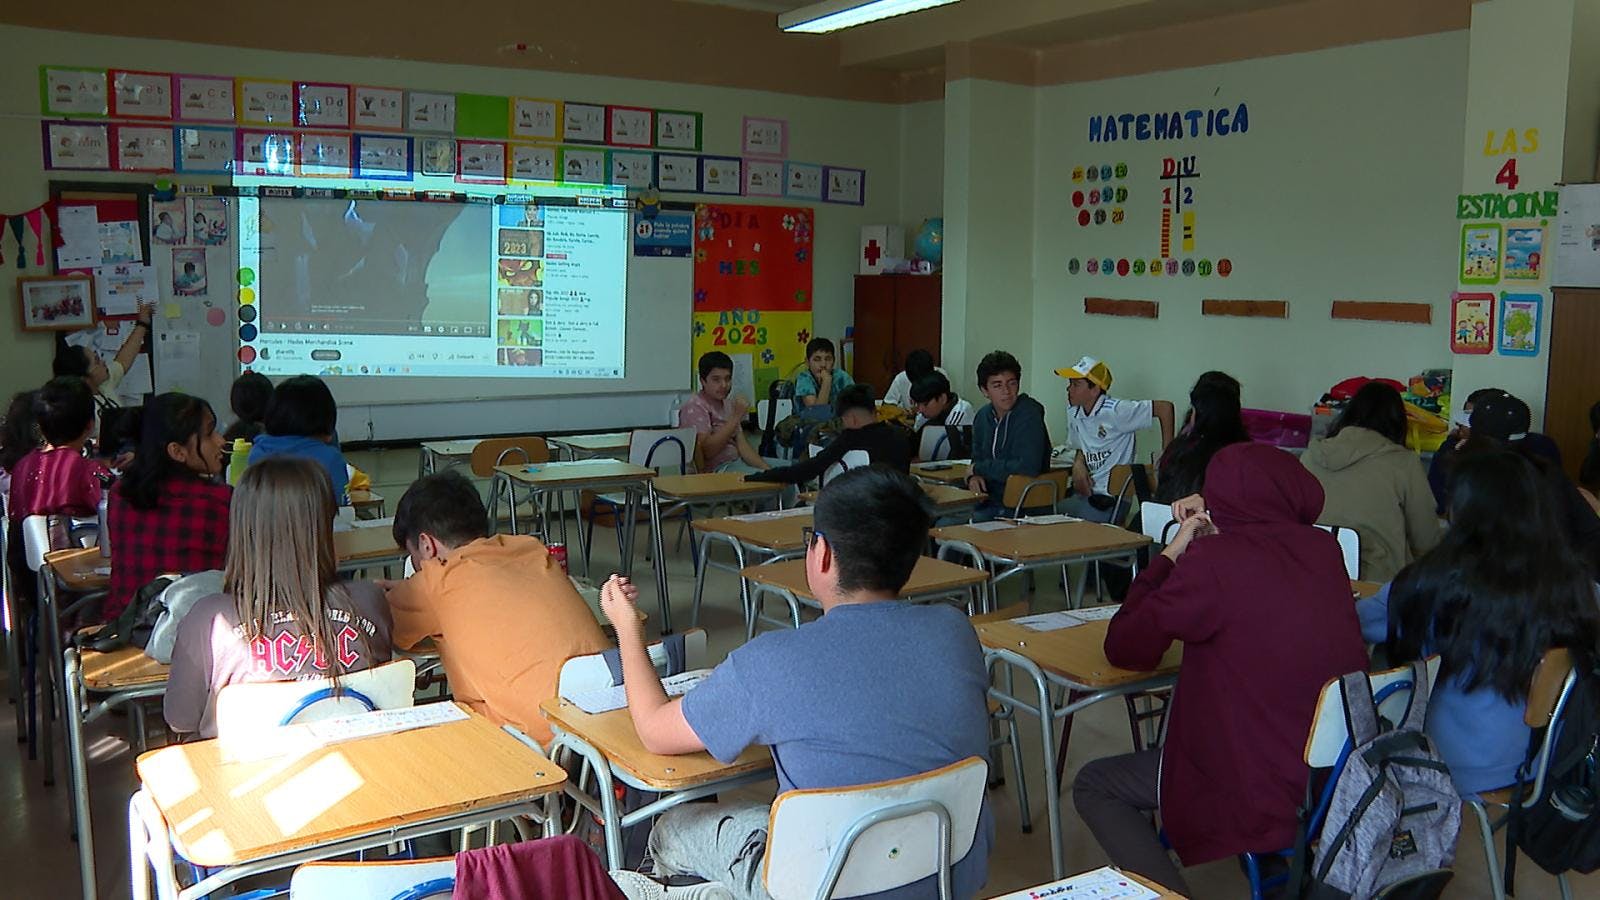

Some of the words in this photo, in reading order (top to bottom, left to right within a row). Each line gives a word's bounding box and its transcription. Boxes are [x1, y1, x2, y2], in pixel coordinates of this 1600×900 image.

[1483, 127, 1540, 157] LAS
[1162, 157, 1176, 176] D
[1182, 155, 1196, 175] U
[1495, 158, 1520, 190] 4
[1162, 187, 1172, 205] 1
[1183, 187, 1193, 205] 2
[719, 260, 761, 276] MES
[1133, 260, 1146, 274] 50
[1198, 260, 1212, 276] 90
[719, 306, 761, 326] AÑO
[712, 324, 769, 346] 2023
